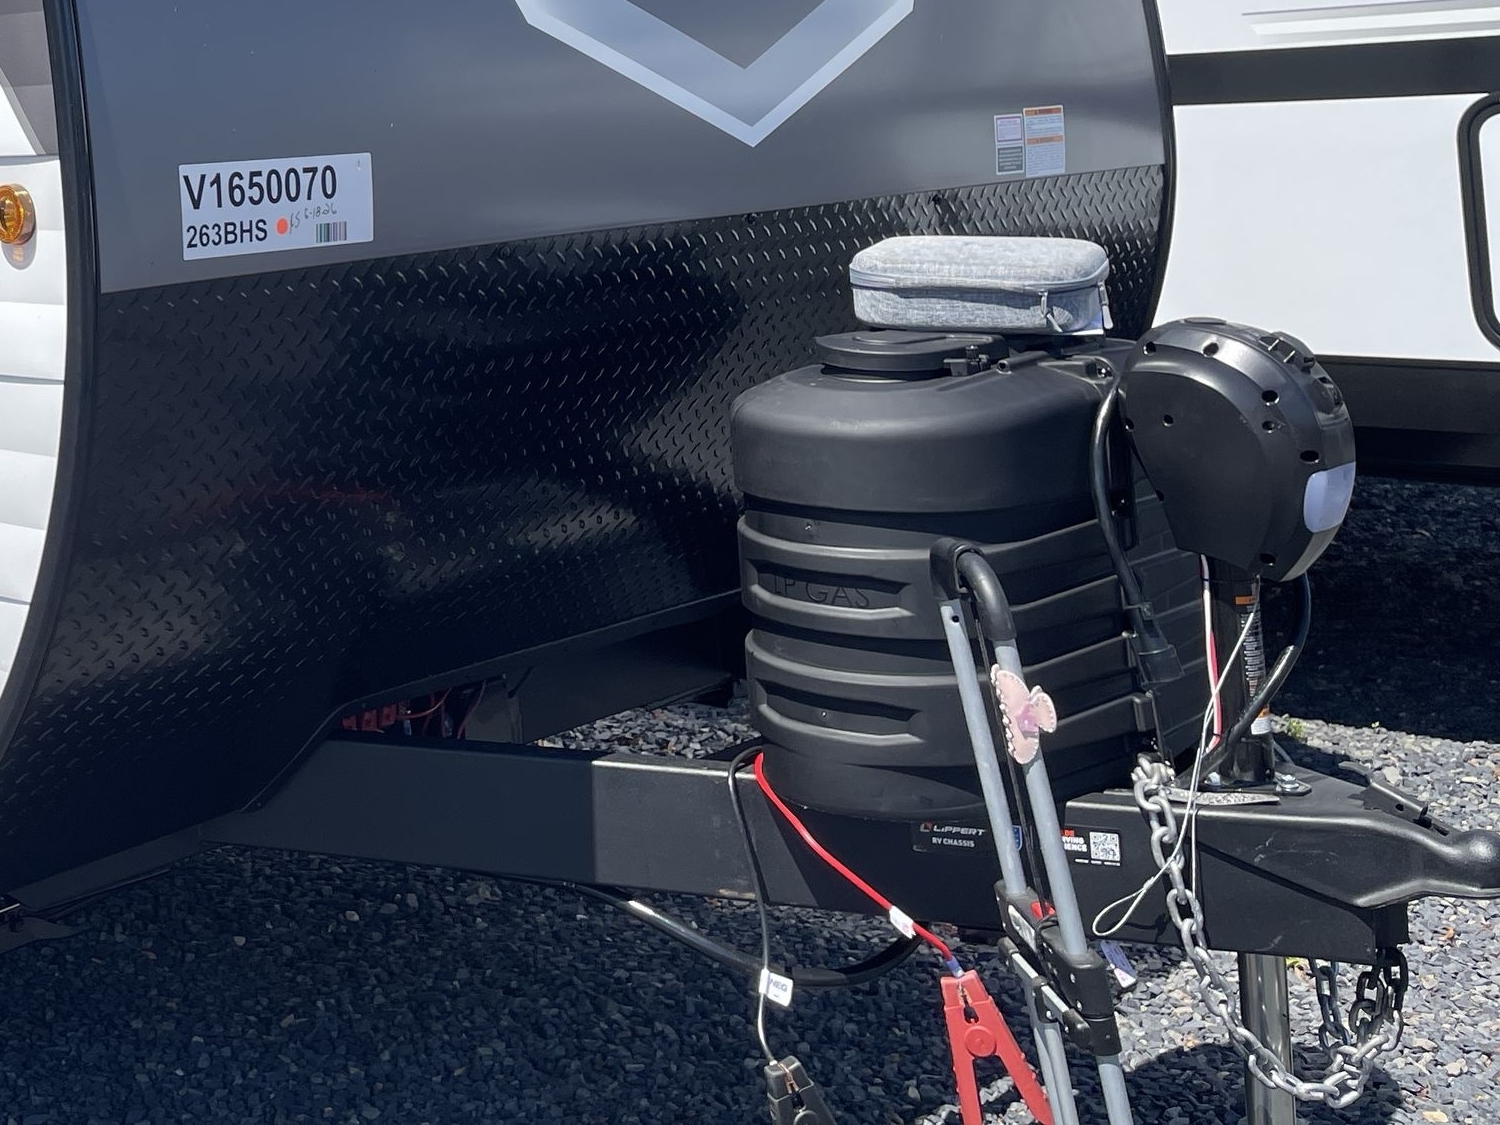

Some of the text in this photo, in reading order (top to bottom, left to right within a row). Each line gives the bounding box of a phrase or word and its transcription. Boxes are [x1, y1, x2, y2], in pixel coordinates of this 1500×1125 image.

[182, 165, 338, 210] V1650070
[186, 219, 268, 248] 263BHS
[806, 582, 870, 608] GAS
[933, 824, 986, 835] LIPPERT
[942, 838, 975, 848] CHASSIS
